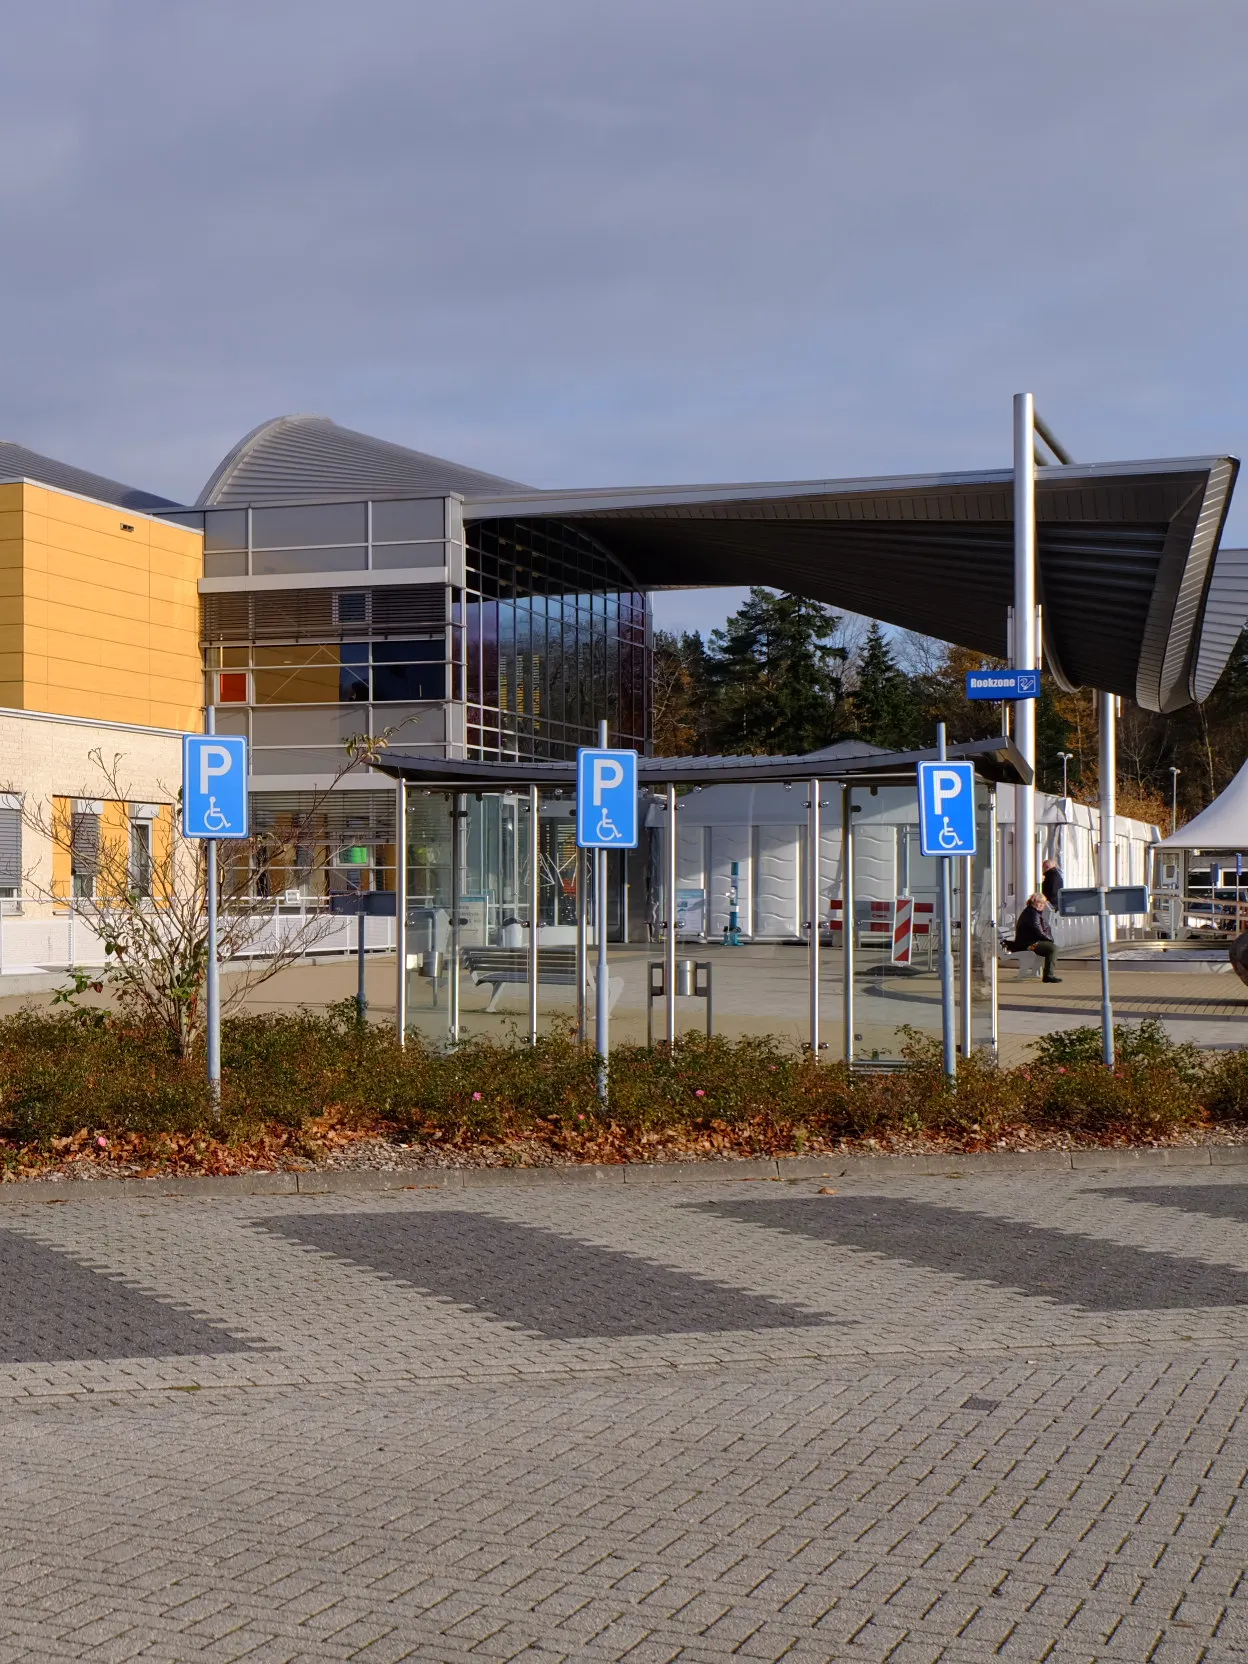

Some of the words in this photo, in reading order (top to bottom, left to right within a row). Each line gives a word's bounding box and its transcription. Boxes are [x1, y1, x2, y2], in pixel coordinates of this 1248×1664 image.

[970, 678, 1016, 688] Rookzone
[200, 745, 232, 794] P
[593, 759, 624, 806] P
[933, 770, 962, 815] P
